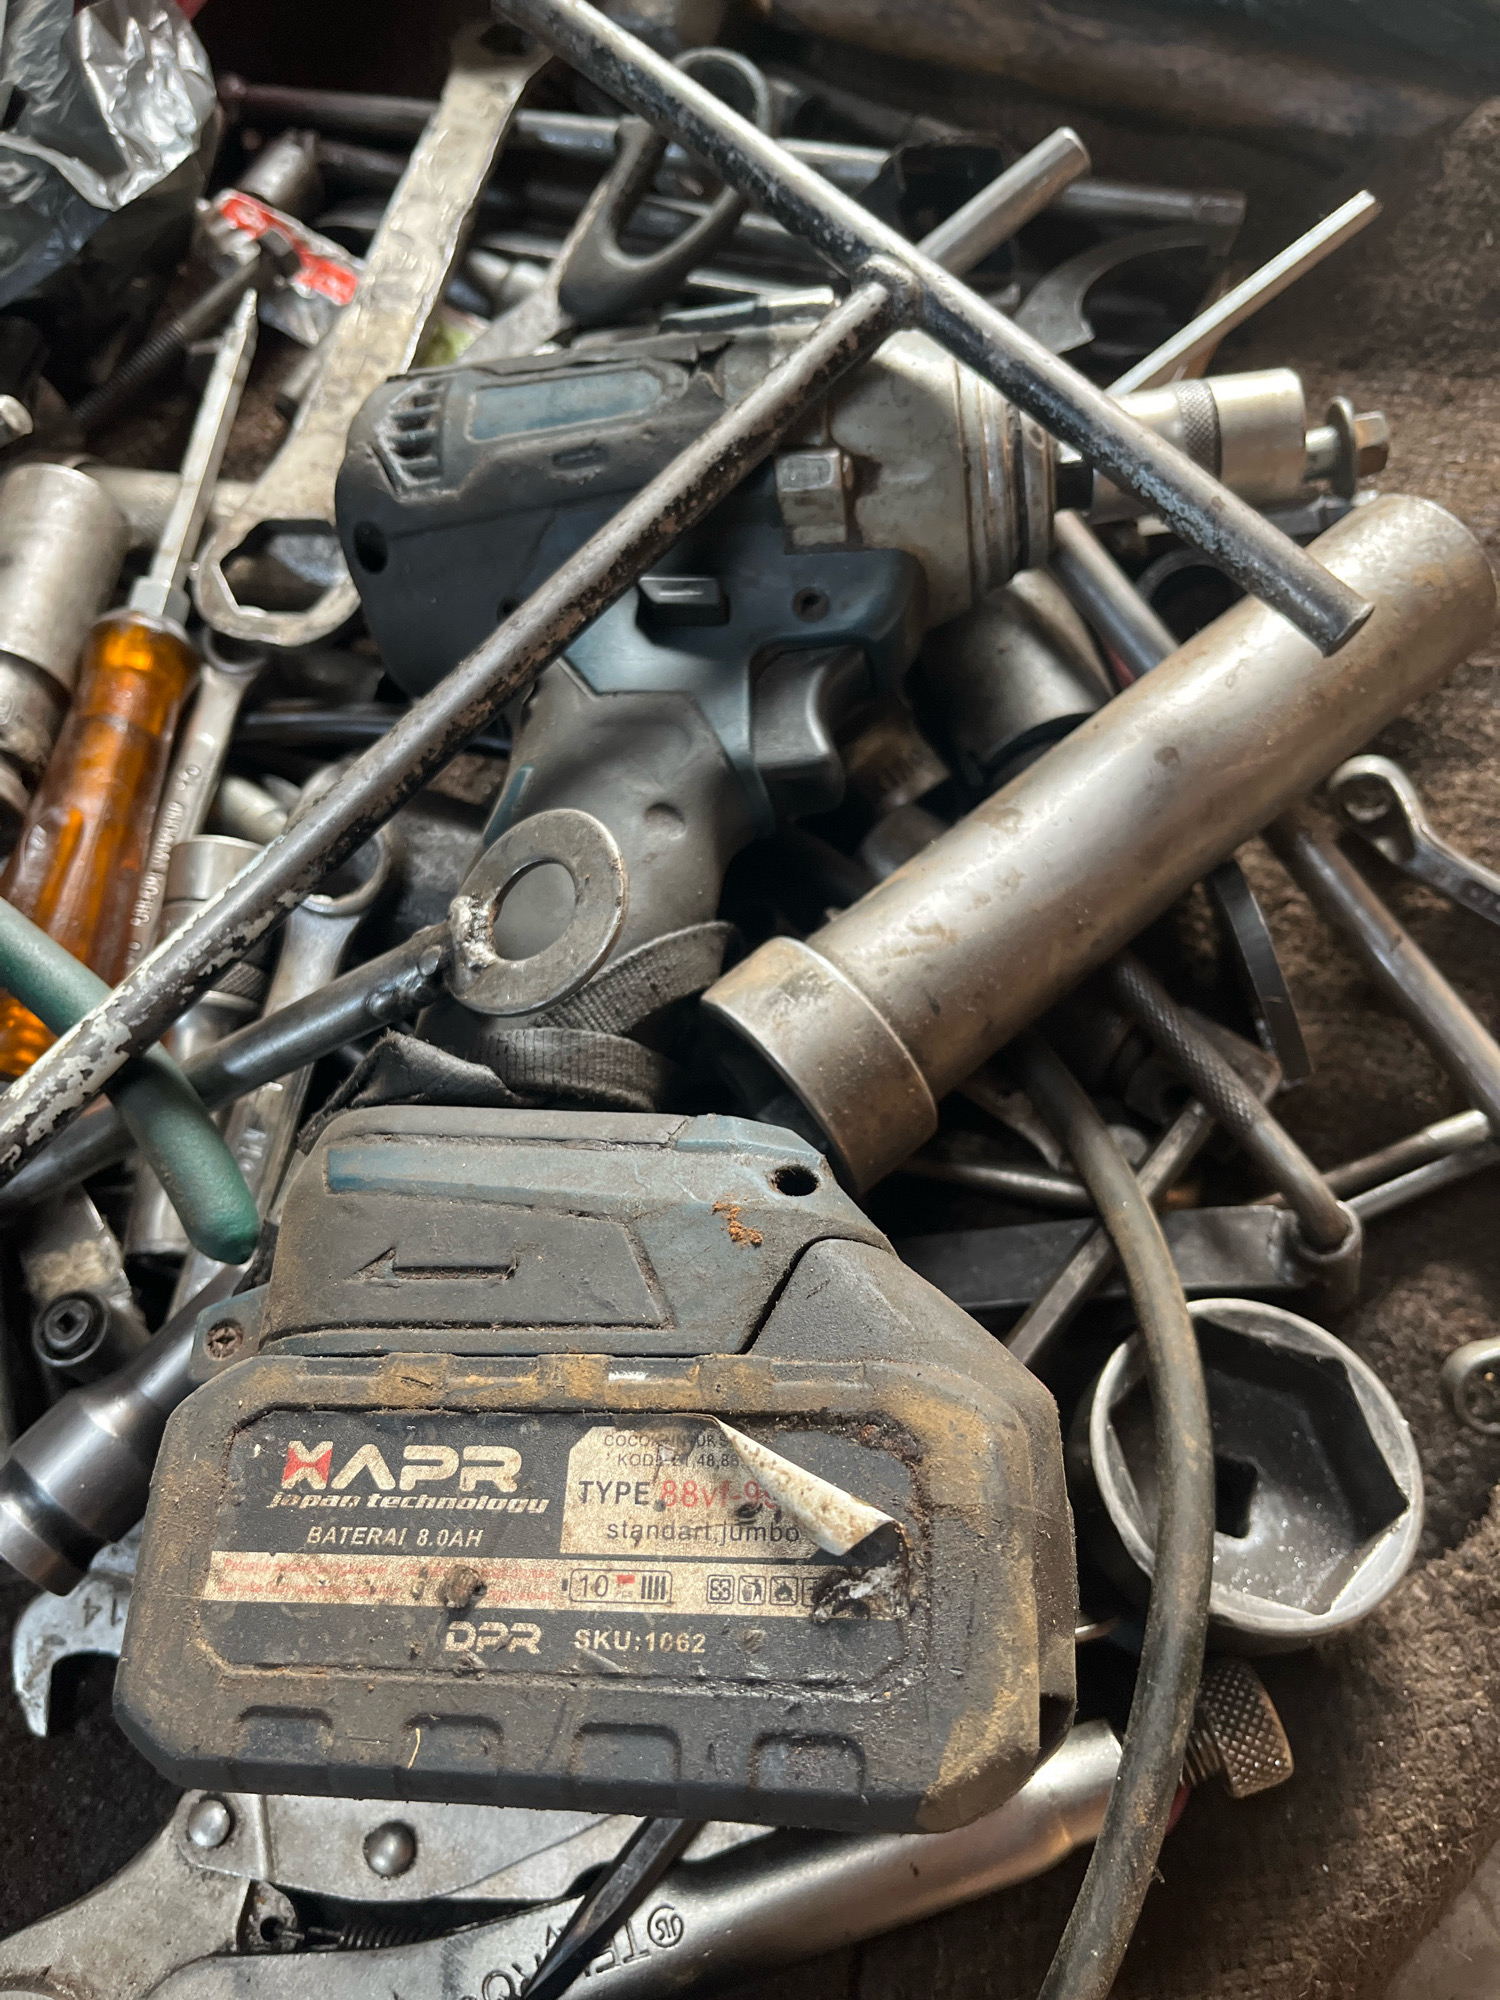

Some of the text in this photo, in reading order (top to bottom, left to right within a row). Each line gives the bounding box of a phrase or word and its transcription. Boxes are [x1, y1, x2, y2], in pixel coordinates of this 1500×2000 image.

[266, 1491, 550, 1514] japan technology
[578, 1480, 650, 1506] TYPE
[306, 1526, 484, 1548] BATERAI 8.0AH
[579, 1574, 609, 1597] 10
[445, 1621, 543, 1655] DPR
